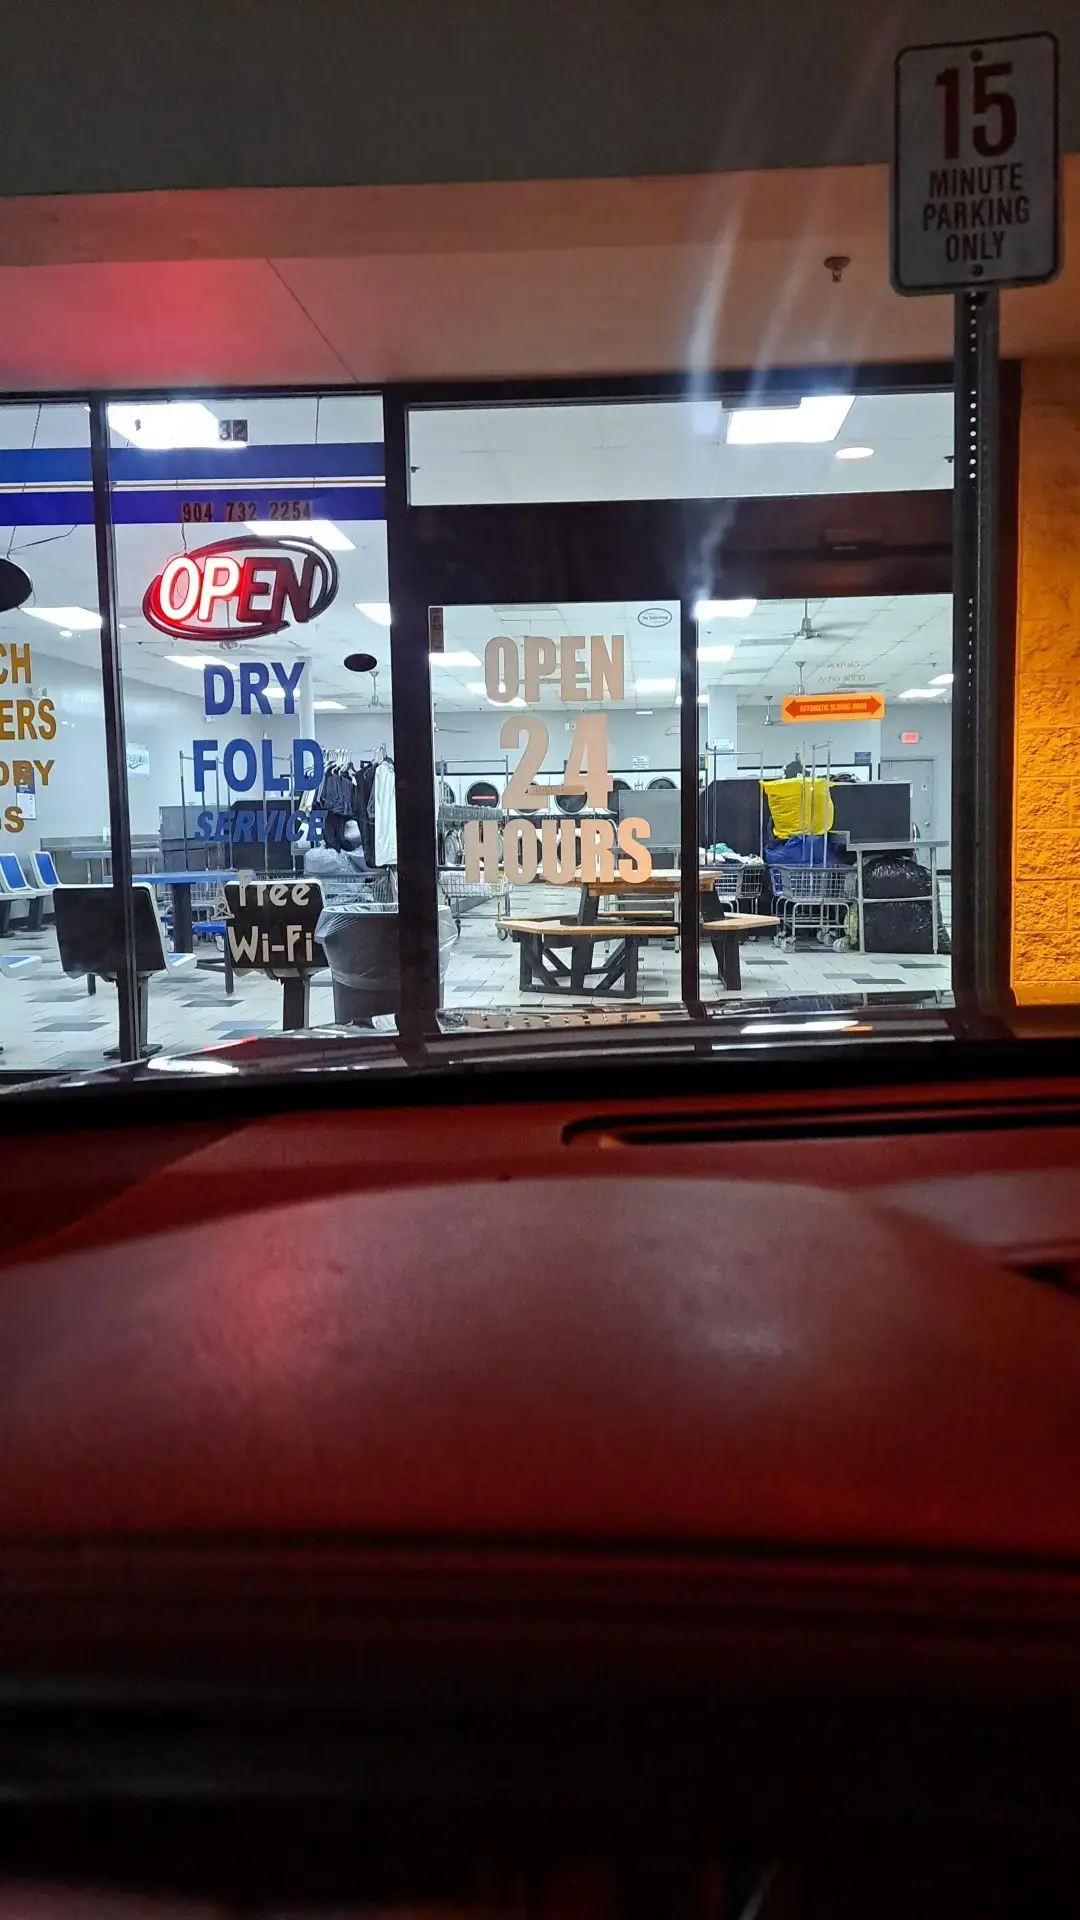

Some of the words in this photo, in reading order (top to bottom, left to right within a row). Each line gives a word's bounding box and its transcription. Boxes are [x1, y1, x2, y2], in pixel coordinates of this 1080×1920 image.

[935, 61, 1017, 160] 15
[929, 162, 1024, 198] MINUTE
[922, 195, 1030, 232] PARKING
[945, 230, 1007, 264] ONLY
[182, 501, 213, 522] 904
[225, 500, 258, 521] 732
[159, 555, 318, 624] OPEN
[203, 661, 306, 716] DRY
[484, 634, 625, 704] OPEN
[192, 738, 325, 793] FOLD
[500, 712, 614, 810] 24
[194, 809, 328, 843] SERVICE
[463, 816, 653, 884] HOURS
[237, 869, 311, 907] Free
[227, 924, 313, 964] Wi-Fi
